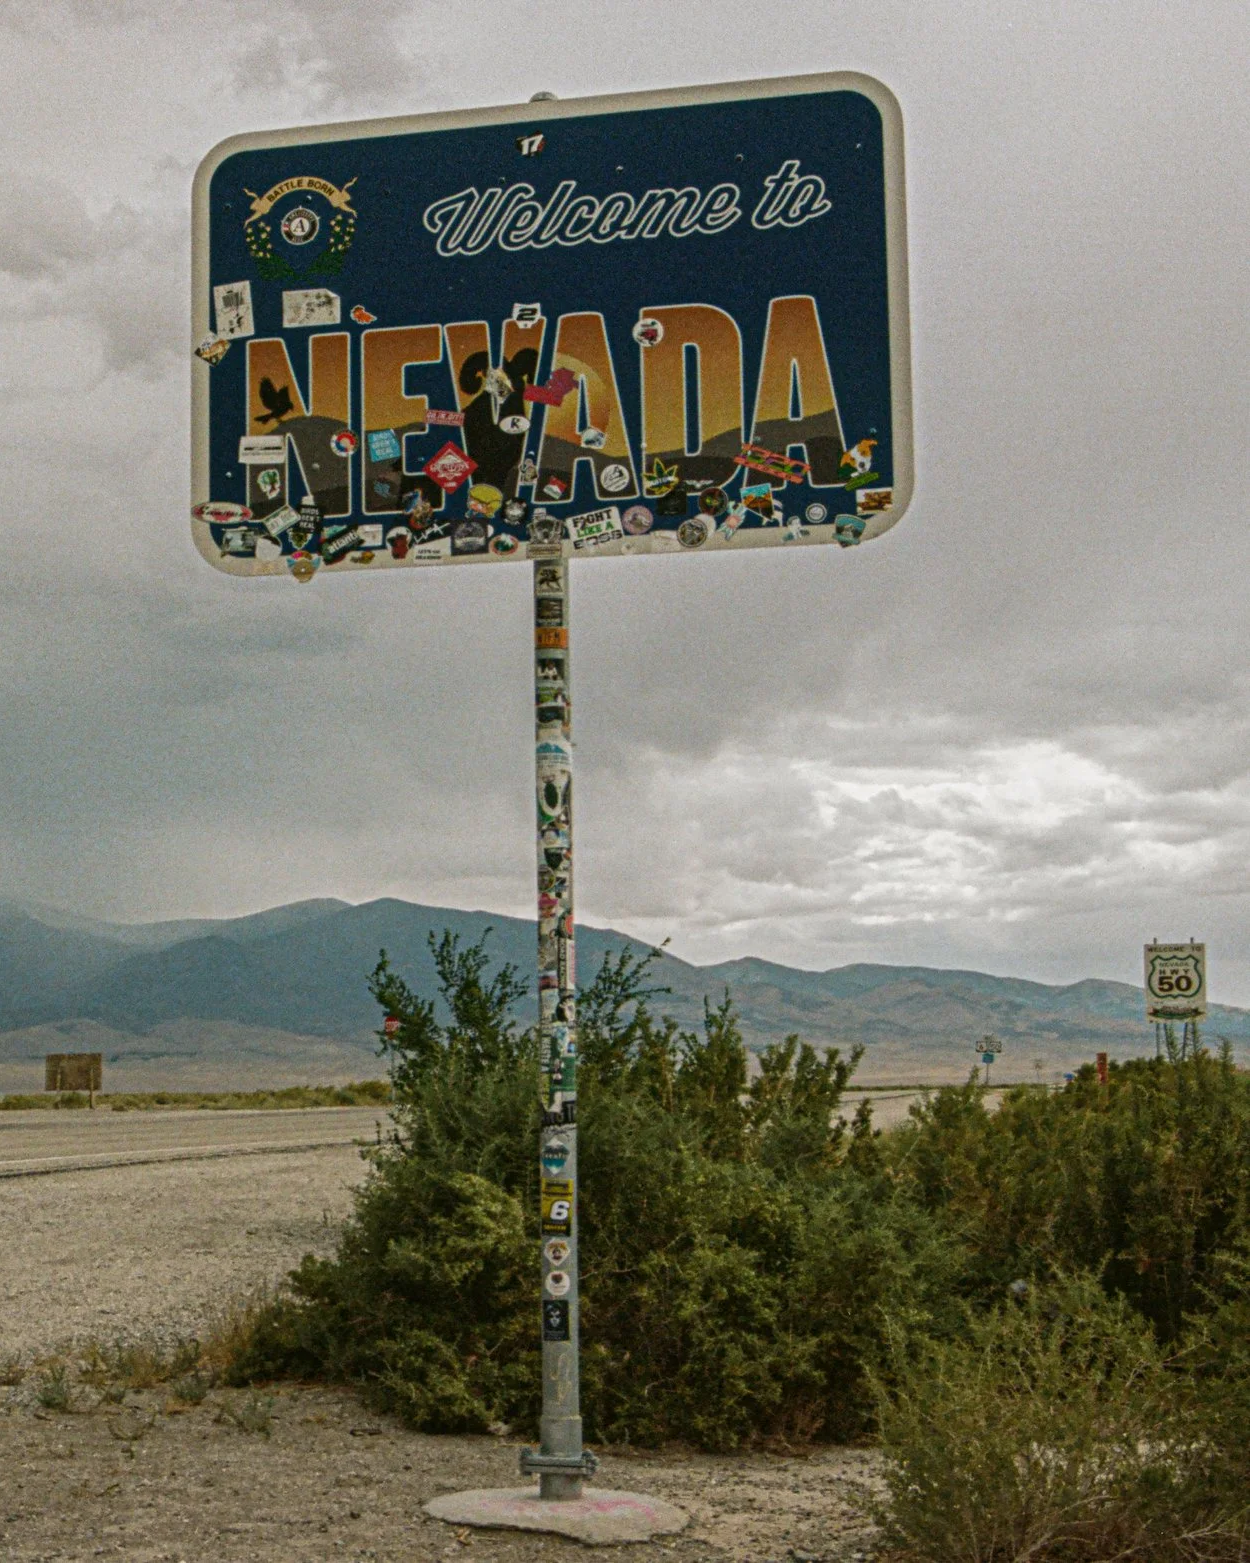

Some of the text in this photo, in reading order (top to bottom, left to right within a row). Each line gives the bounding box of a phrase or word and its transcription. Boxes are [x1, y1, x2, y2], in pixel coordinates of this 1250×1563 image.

[520, 134, 544, 155] 17
[266, 180, 334, 202] BATTLE BORN
[423, 160, 832, 256] Welcome to
[246, 295, 850, 518] NEVADA
[577, 520, 615, 538] LIKE A
[1158, 975, 1193, 992] 50
[550, 1200, 570, 1220] 6
